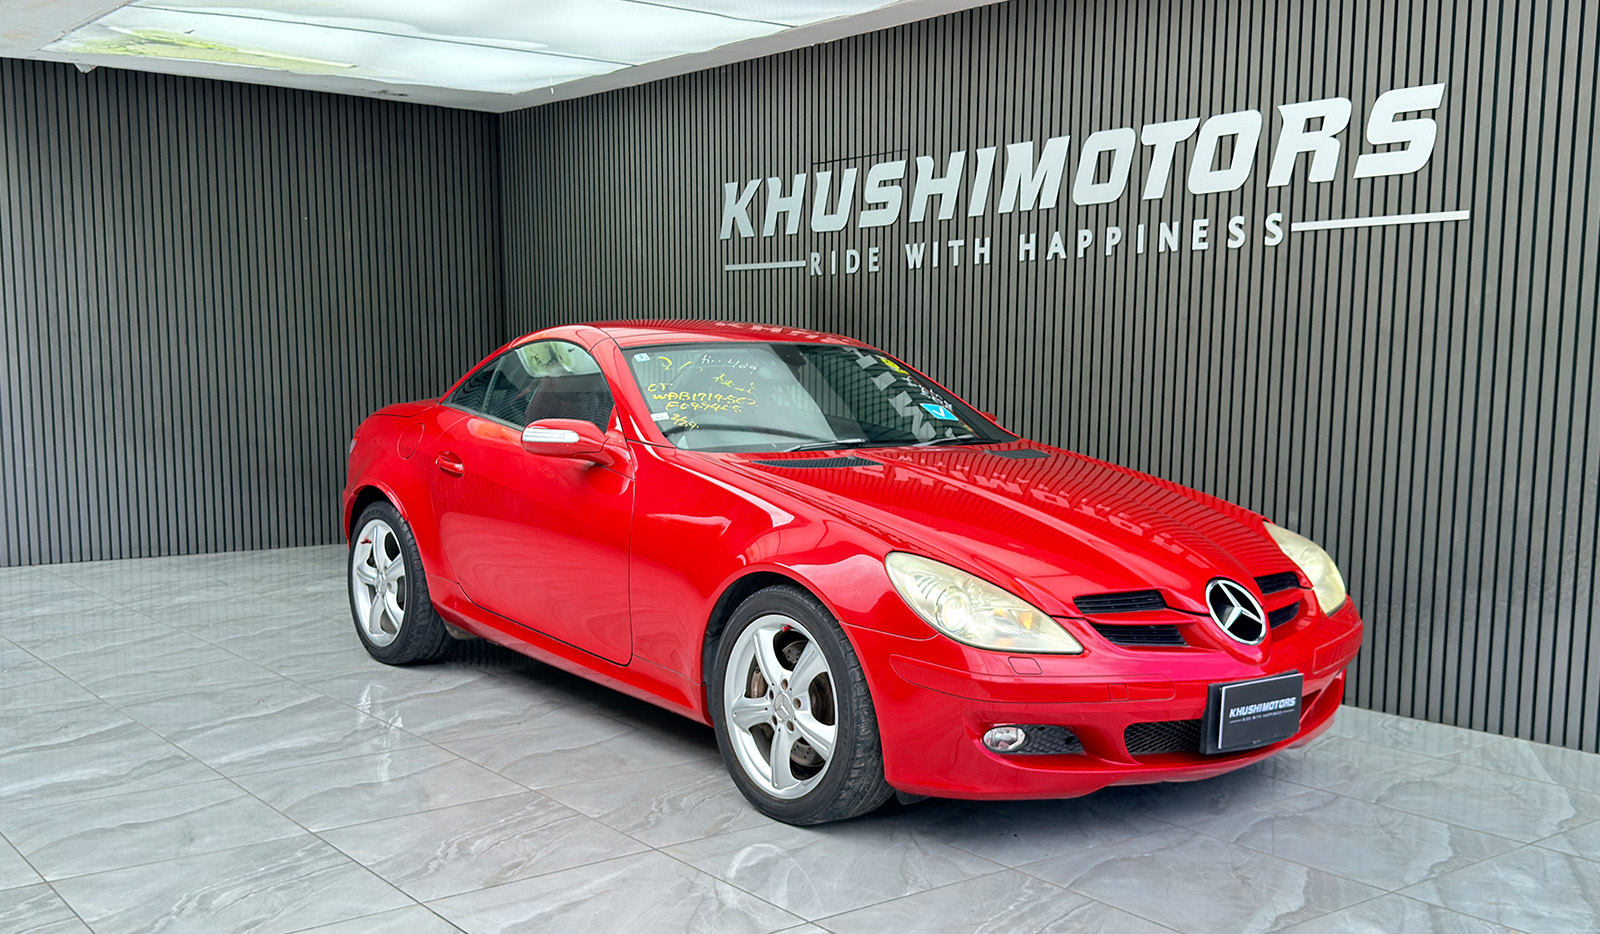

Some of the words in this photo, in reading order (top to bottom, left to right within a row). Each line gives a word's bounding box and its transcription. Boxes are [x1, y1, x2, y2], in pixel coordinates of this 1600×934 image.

[720, 83, 1444, 240] KHUSHIMOTORS
[809, 249, 881, 276] RIDE
[905, 236, 992, 270] WITH
[1020, 212, 1286, 262] HAPPINESS
[1229, 697, 1297, 718] KHUSHIMOTORS
